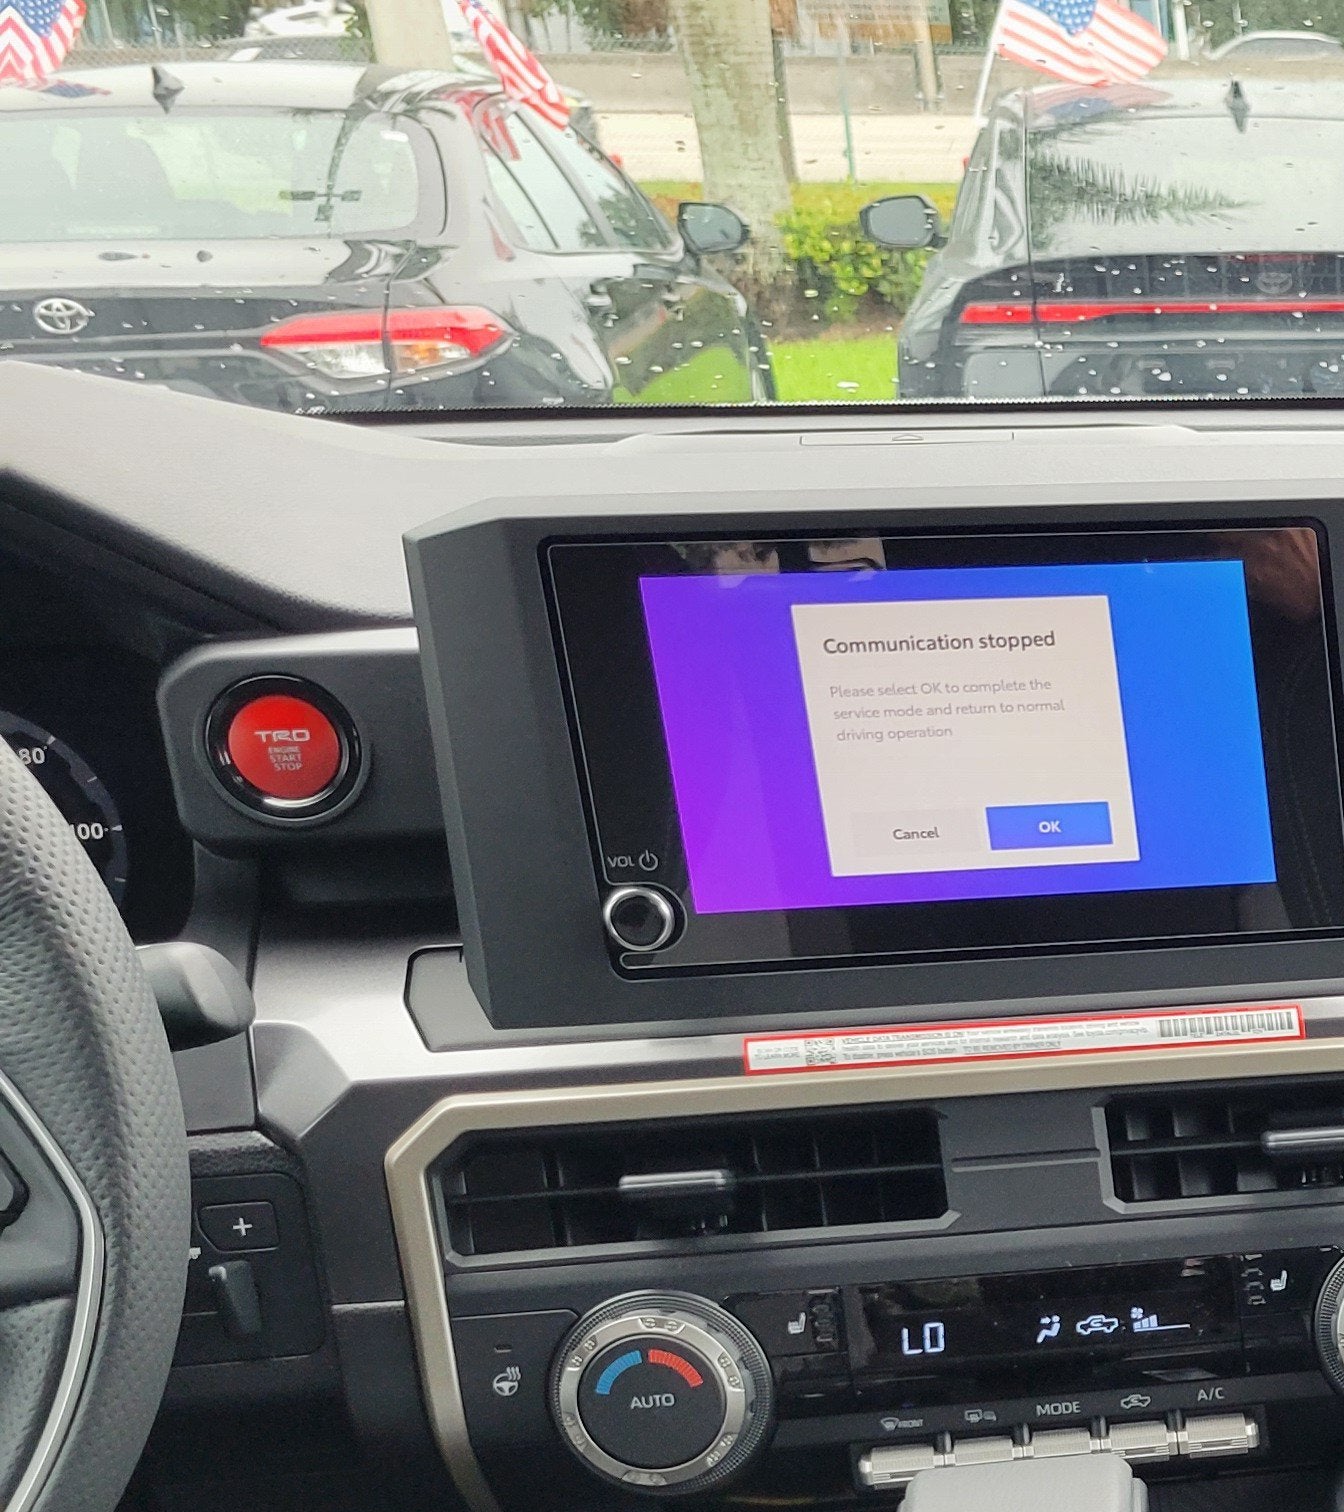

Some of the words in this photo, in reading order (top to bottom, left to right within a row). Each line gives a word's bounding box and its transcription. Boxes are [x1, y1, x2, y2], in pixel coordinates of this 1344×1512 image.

[823, 634, 974, 655] Communication
[979, 630, 1056, 651] stopped
[829, 685, 875, 698] Please
[878, 682, 917, 696] select
[920, 682, 943, 695] OK
[945, 683, 960, 694] to
[963, 680, 1026, 696] complete
[1029, 678, 1051, 691] the
[833, 707, 880, 720] service
[883, 704, 923, 718] mode
[927, 702, 952, 716] and
[955, 702, 996, 716] return
[999, 702, 1014, 714] to
[1017, 699, 1065, 713] normal
[254, 729, 310, 743] TRD
[837, 728, 883, 743] driving
[887, 726, 953, 742] operation
[18, 747, 45, 765] 80
[269, 753, 301, 763] START
[274, 763, 303, 771] STOP
[893, 826, 940, 841] Cancel
[1039, 819, 1062, 834] OK
[608, 855, 635, 868] VOL
[630, 1393, 675, 1409] AUTO
[1197, 1387, 1225, 1401] A/C
[1036, 1401, 1081, 1417] MODE
